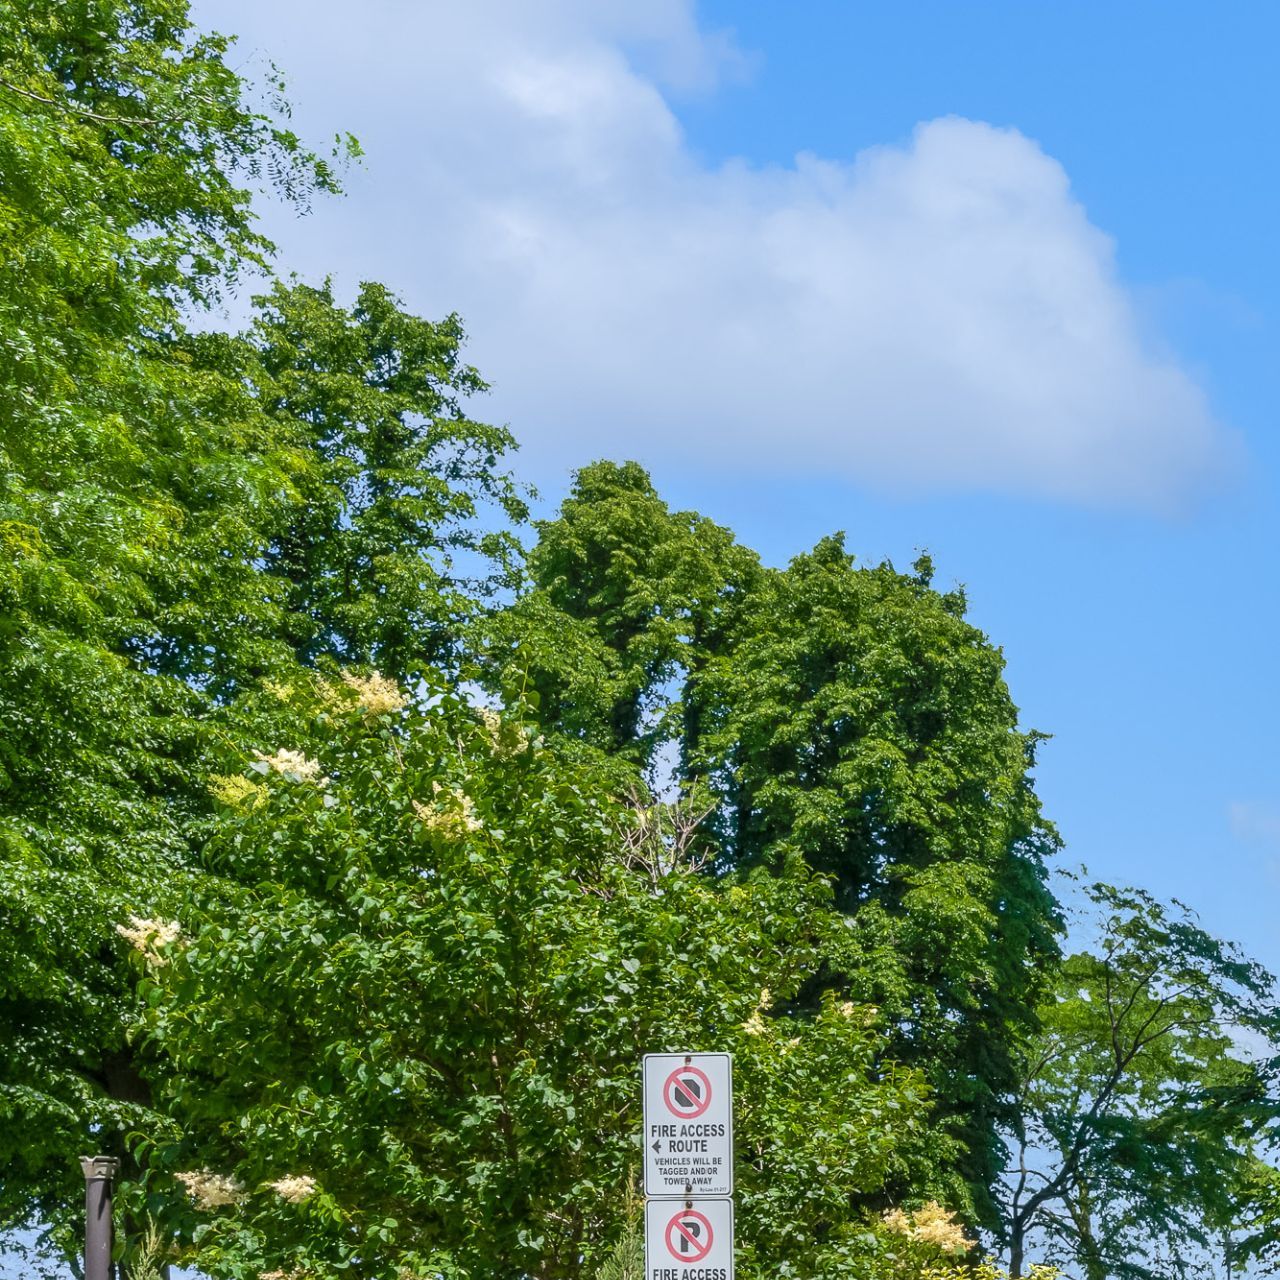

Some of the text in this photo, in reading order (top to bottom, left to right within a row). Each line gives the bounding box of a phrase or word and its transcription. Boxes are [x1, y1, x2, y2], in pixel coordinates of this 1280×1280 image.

[652, 1124, 724, 1137] FIRE ACCESS
[669, 1140, 708, 1152] ROUTE
[654, 1158, 690, 1166] VEHICLES
[653, 1268, 726, 1280] FIRE ACCESS
